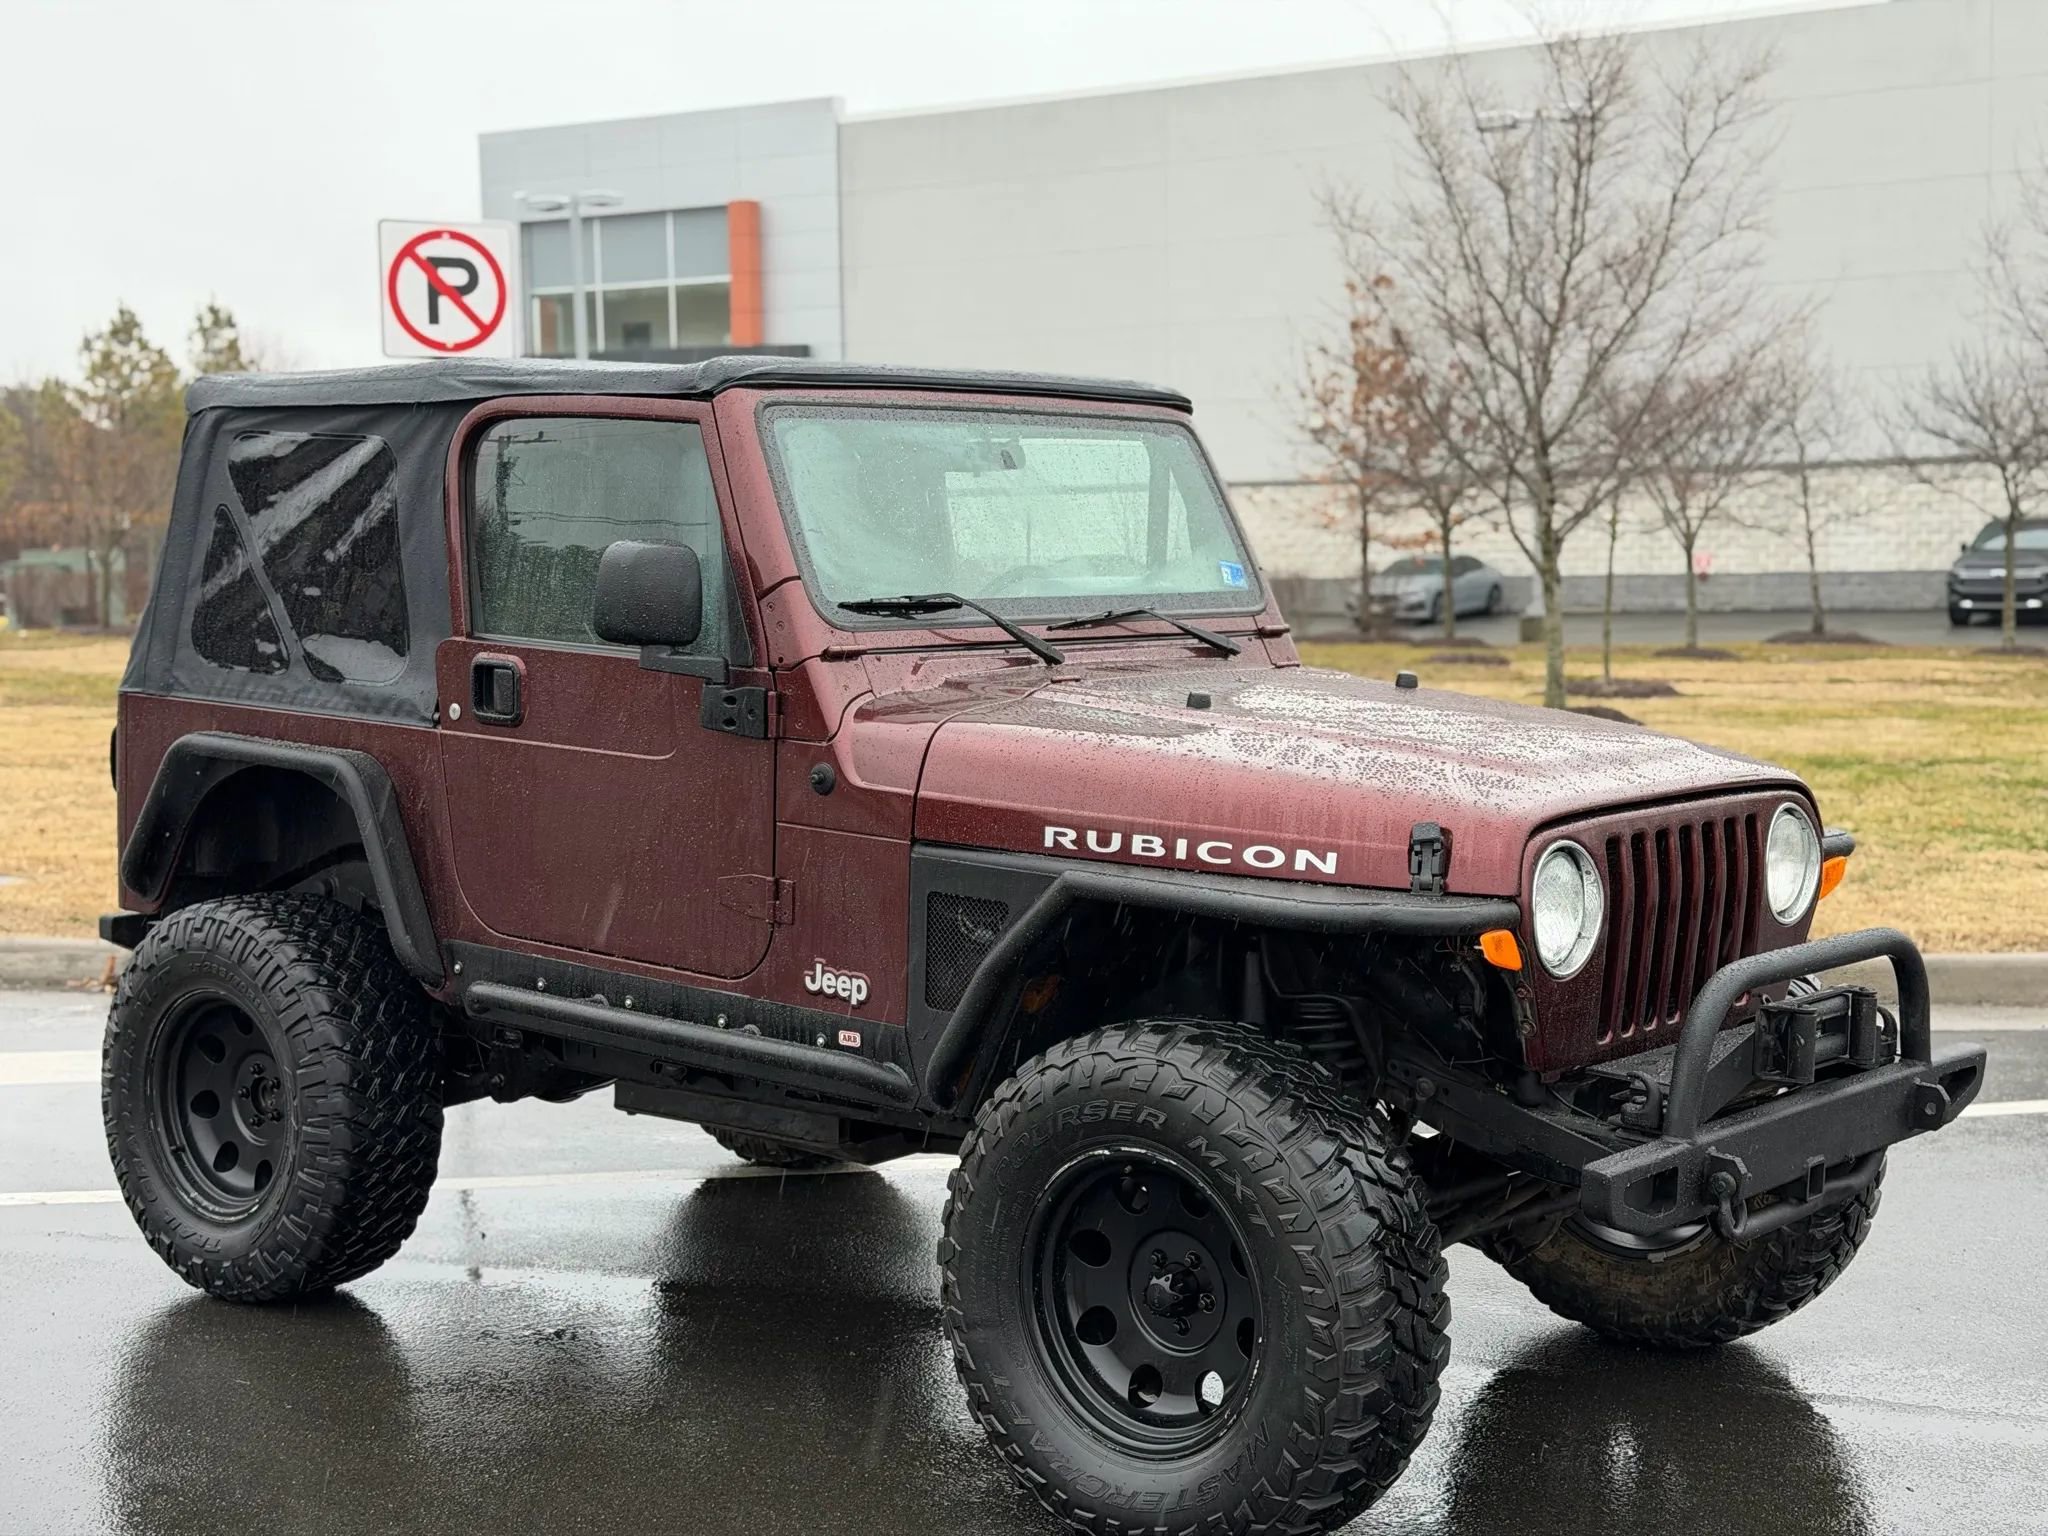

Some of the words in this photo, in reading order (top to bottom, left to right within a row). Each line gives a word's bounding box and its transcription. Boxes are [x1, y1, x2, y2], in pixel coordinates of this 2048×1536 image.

[426, 256, 479, 325] P
[1044, 826, 1338, 875] RUBICON
[804, 962, 868, 1006] Jeep
[841, 1034, 858, 1044] ARB
[993, 1099, 1168, 1200] COURSER
[1184, 1135, 1276, 1239] MXT
